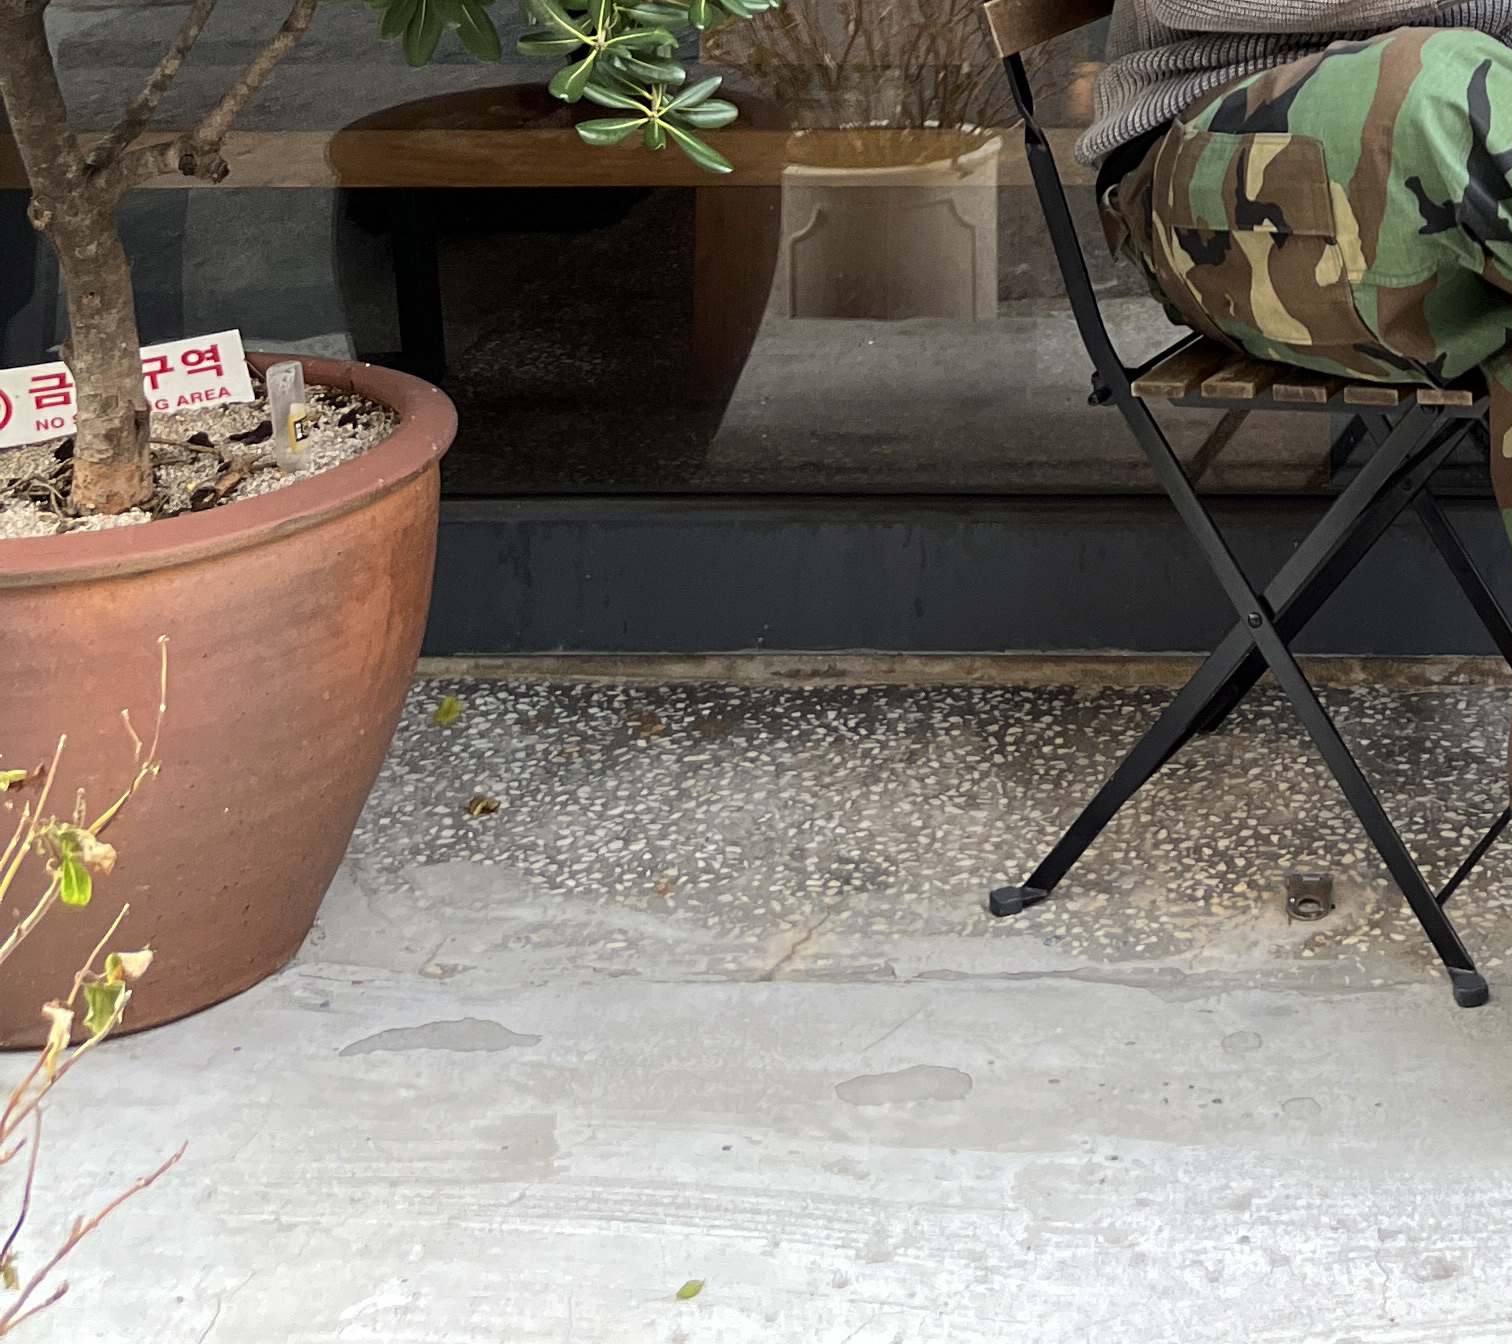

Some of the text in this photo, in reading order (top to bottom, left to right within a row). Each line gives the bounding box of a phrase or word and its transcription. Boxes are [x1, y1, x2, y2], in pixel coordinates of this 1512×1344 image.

[28, 343, 224, 410] 금구역
[35, 386, 232, 432] NO AREA
